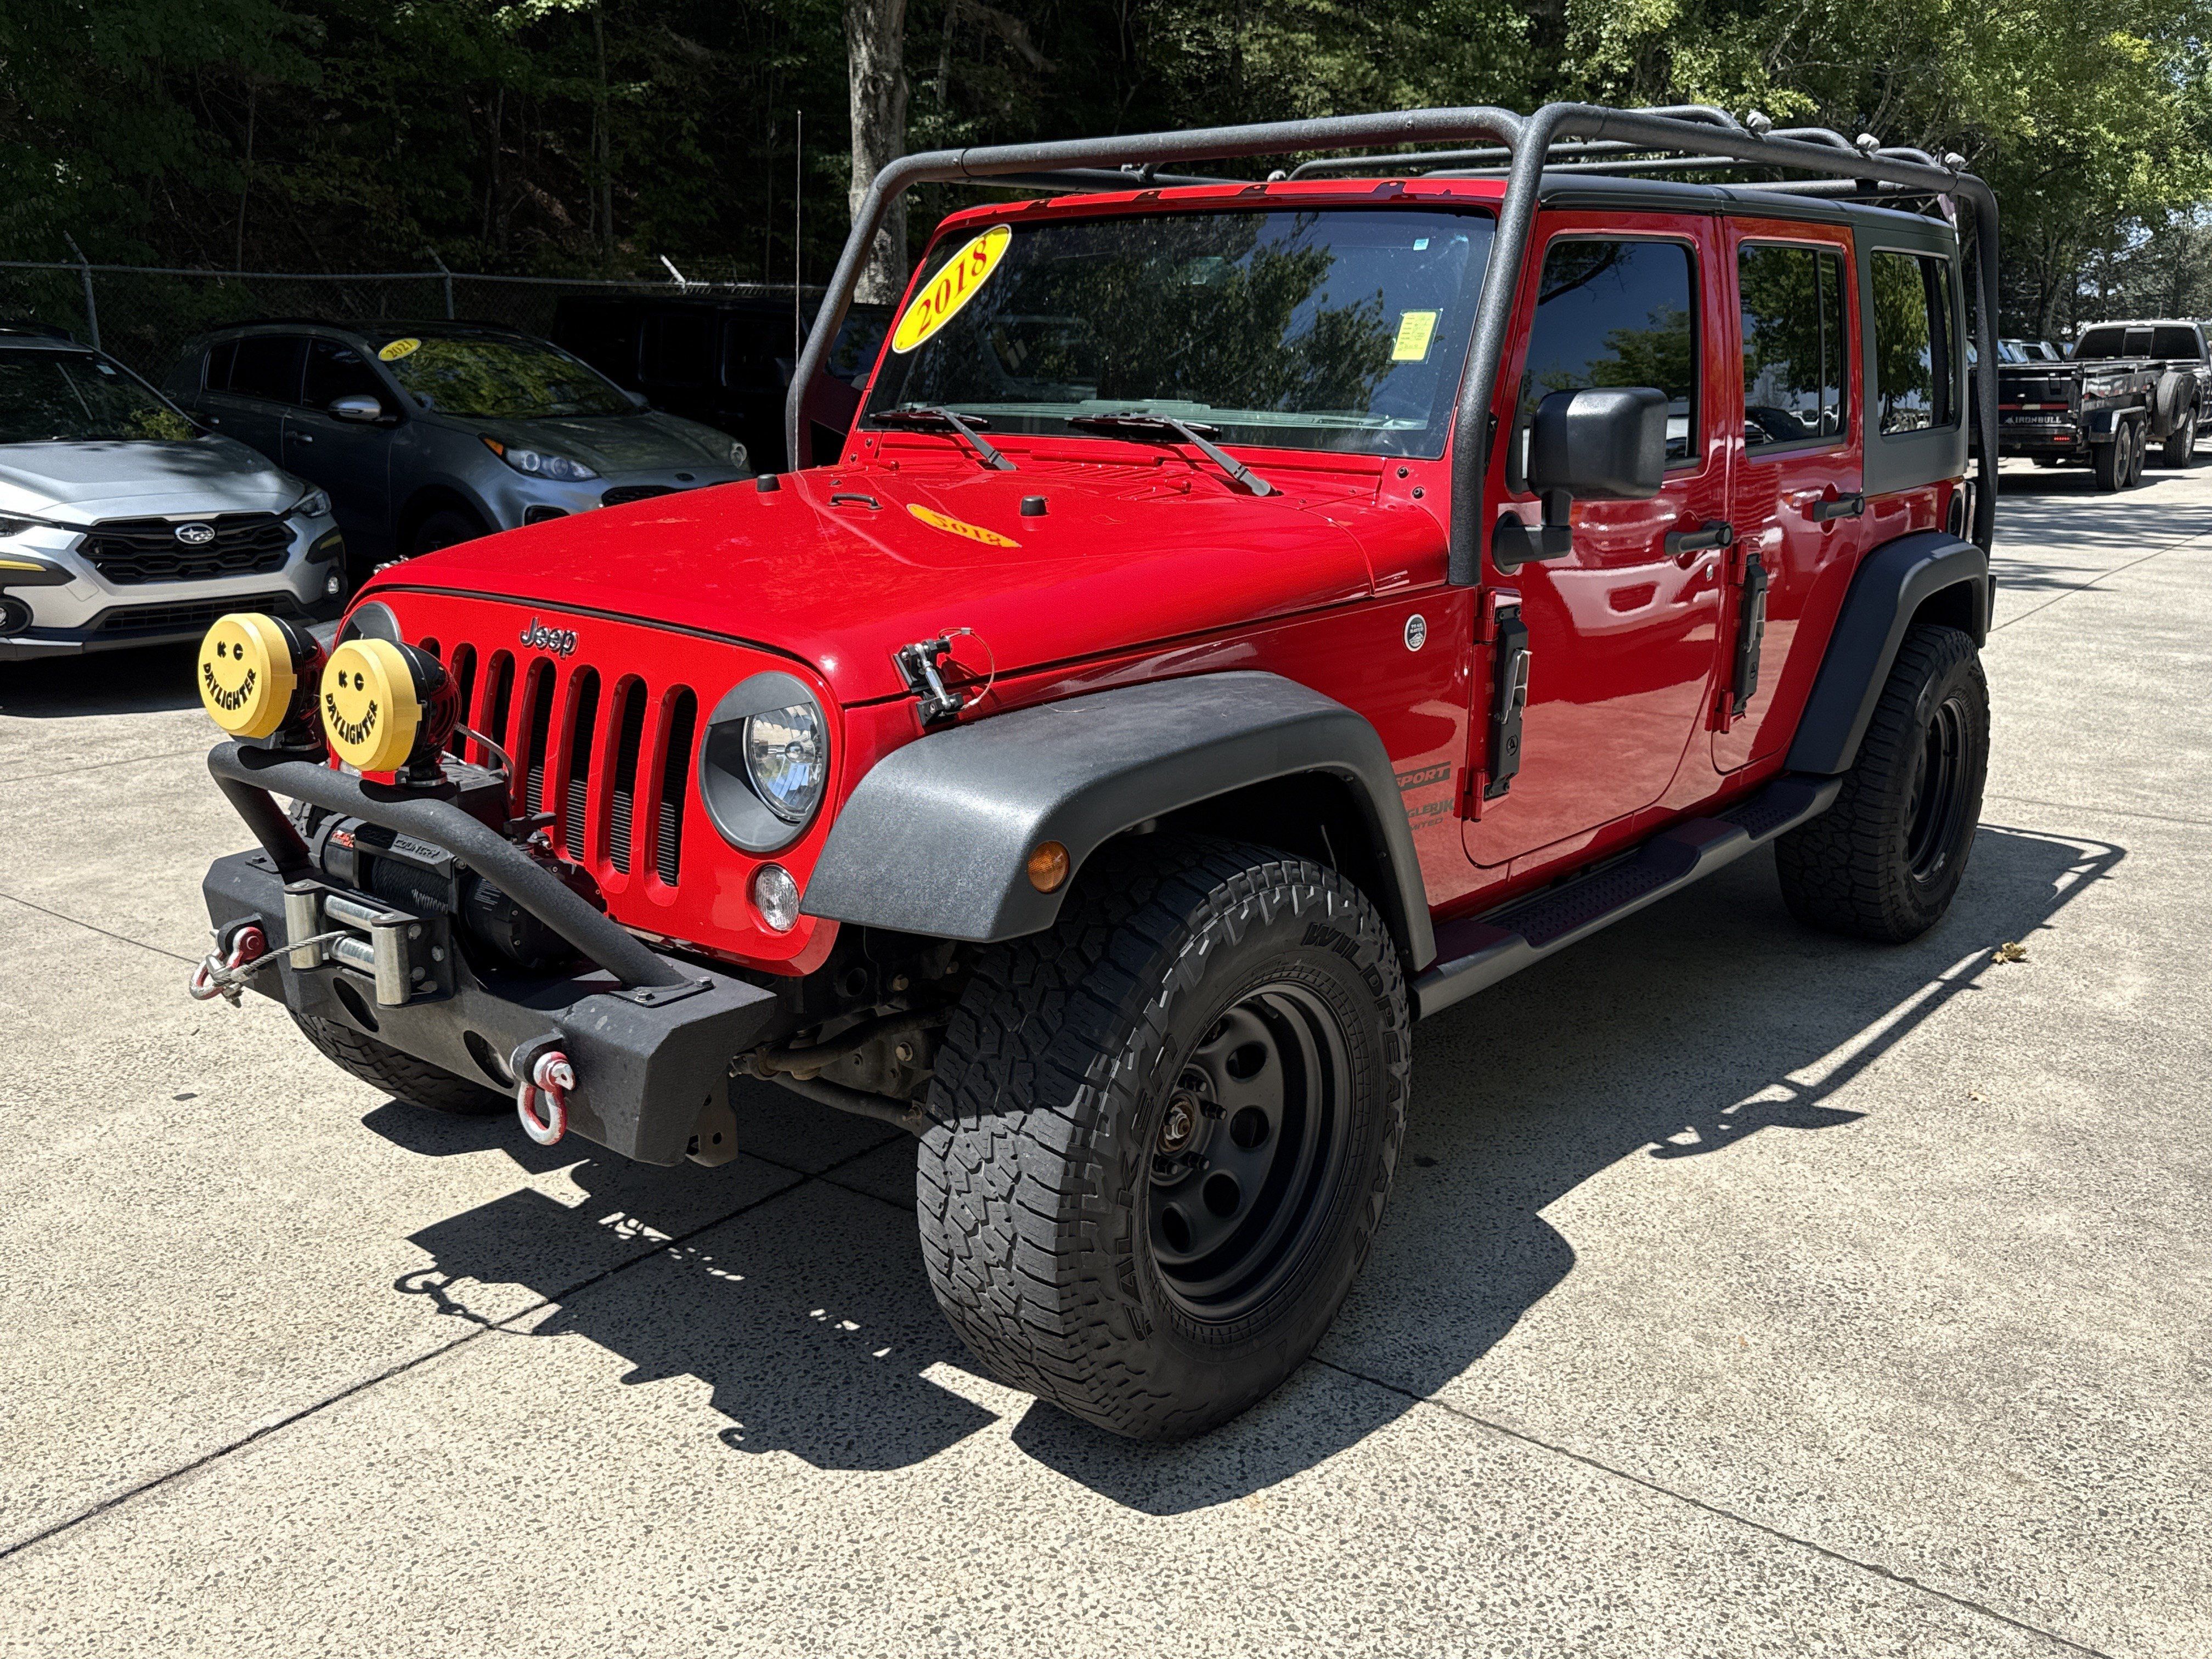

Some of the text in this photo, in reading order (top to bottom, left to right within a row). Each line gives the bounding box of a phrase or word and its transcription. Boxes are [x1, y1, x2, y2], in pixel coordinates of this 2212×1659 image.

[917, 240, 986, 337] 2018
[386, 340, 413, 358] 2021
[520, 616, 578, 660] Jeep
[203, 662, 256, 710] DAYLIGHTER
[325, 692, 377, 744] DAYLIGHTER
[393, 839, 440, 859] COUNTRY
[1301, 922, 1401, 1149] WILDPEAK
[1115, 1034, 1180, 1348] FALKEN
